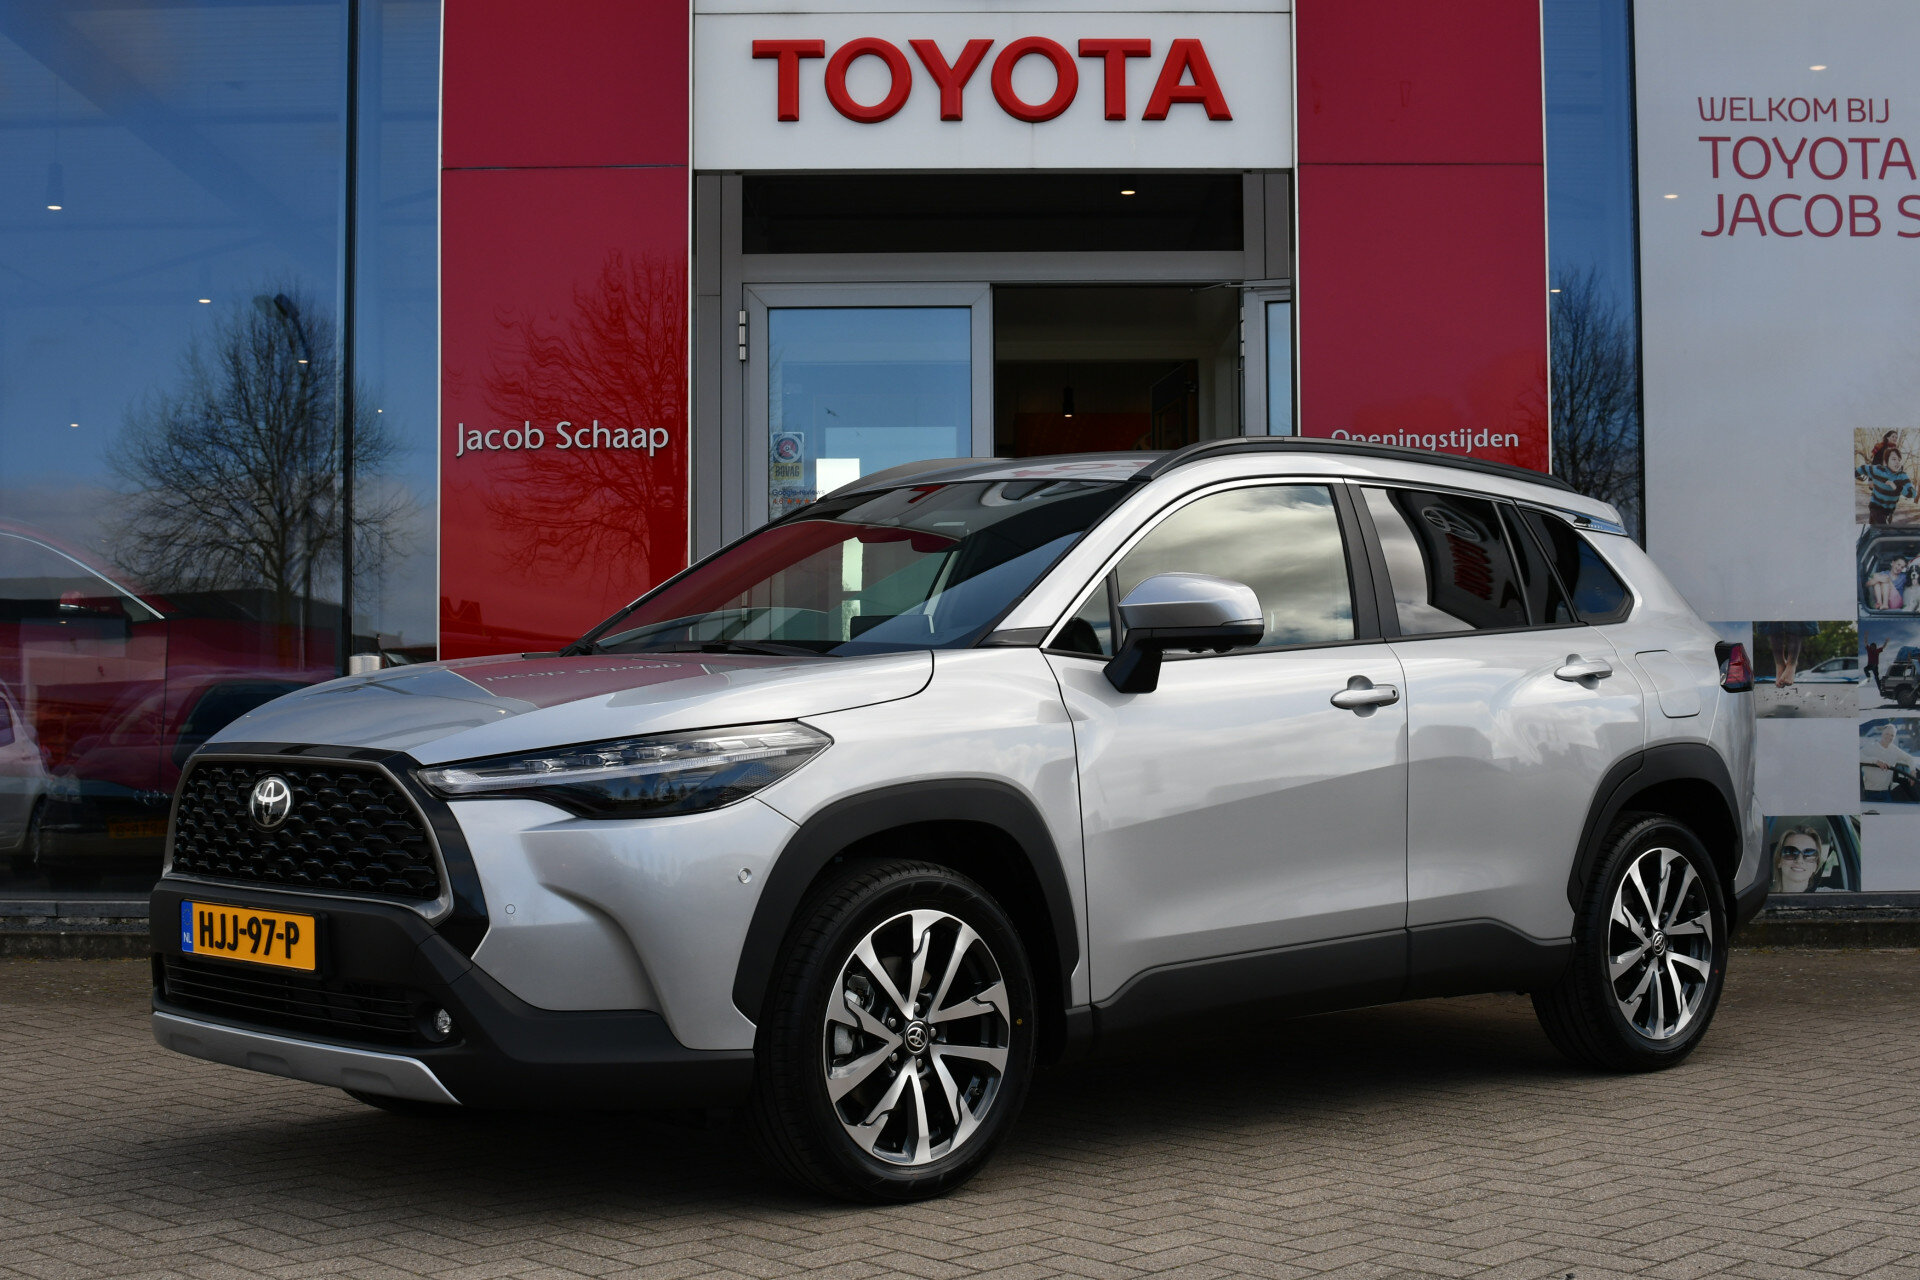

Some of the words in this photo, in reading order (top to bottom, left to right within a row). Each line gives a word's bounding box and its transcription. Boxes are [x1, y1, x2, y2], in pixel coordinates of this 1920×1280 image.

[752, 36, 1233, 123] TOYOTA
[1698, 97, 1837, 122] WELKOM
[1848, 98, 1889, 123] BIJ
[1699, 136, 1917, 180] TOYOTA
[1700, 193, 1882, 238] JACOB
[456, 421, 544, 457] Jacob
[555, 420, 669, 457] Schaap
[775, 465, 800, 477] BOVAG
[183, 931, 192, 943] NL
[199, 910, 300, 959] HJJ-97-P
